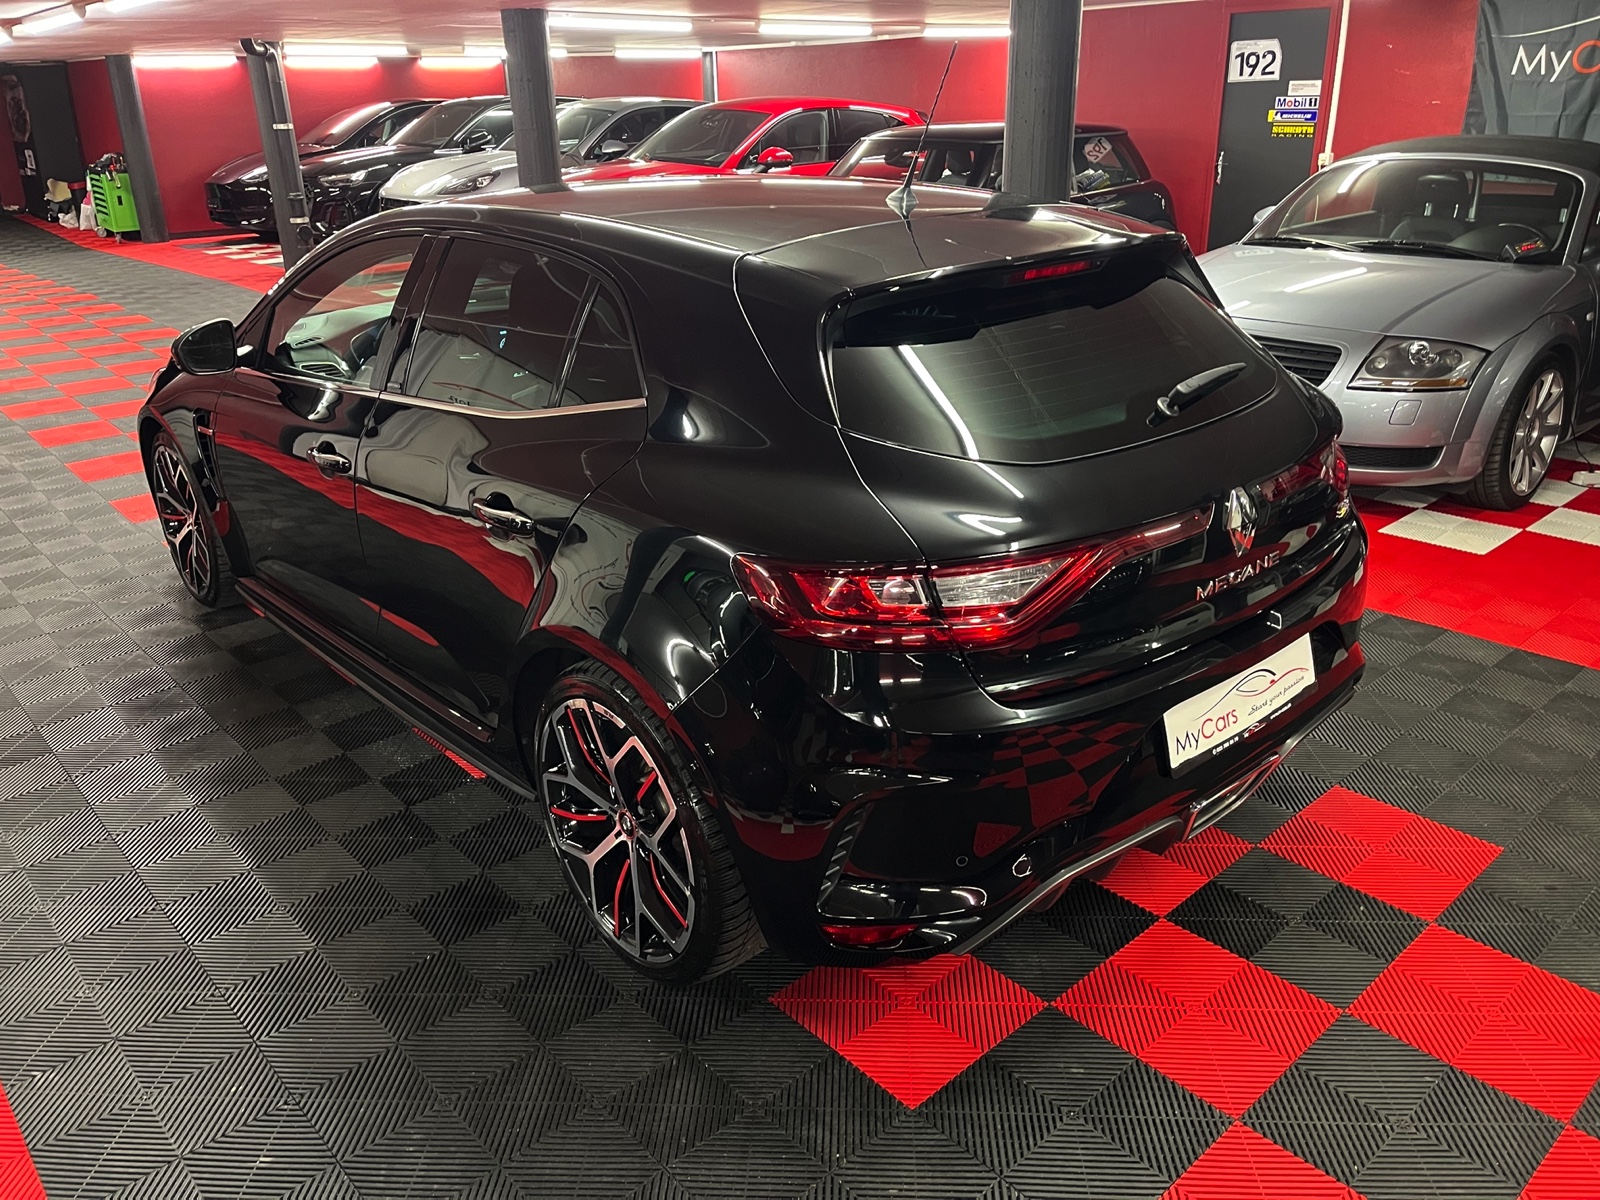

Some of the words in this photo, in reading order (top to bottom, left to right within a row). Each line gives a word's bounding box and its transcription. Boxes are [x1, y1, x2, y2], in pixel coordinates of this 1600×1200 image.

[1235, 50, 1276, 77] 192
[1277, 98, 1307, 107] Mobil
[1196, 551, 1279, 601] MEGANE
[1176, 709, 1238, 755] MyCars
